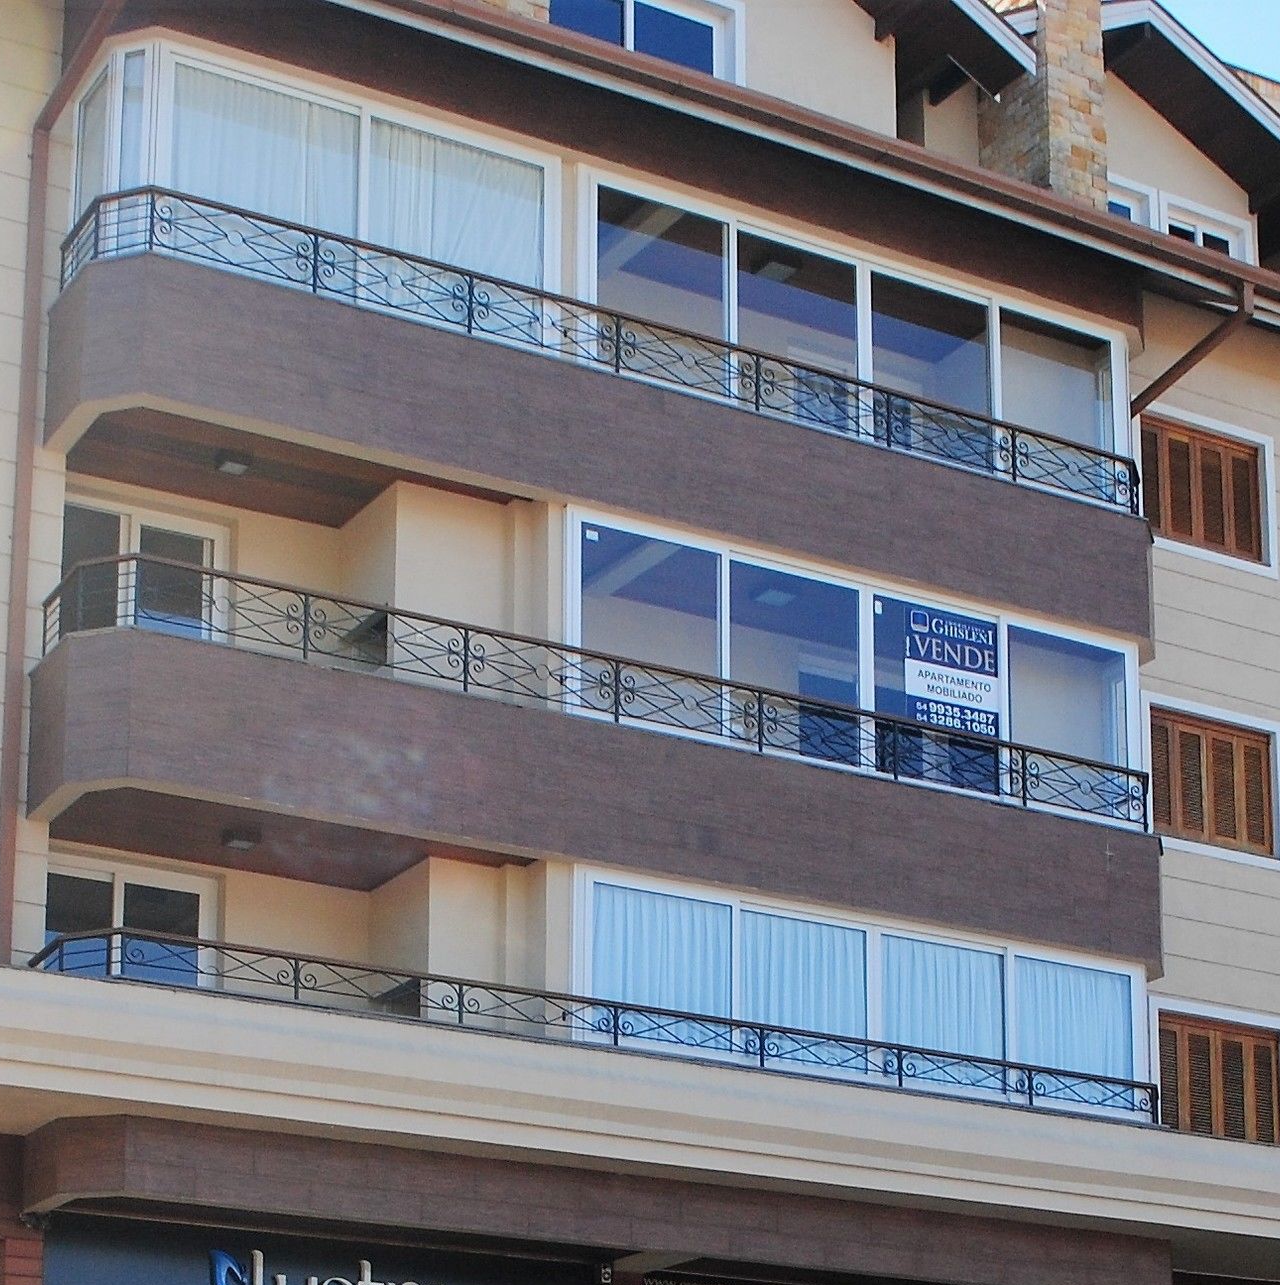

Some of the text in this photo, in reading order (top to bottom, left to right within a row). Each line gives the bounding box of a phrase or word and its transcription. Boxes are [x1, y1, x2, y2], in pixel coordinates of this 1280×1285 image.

[913, 633, 996, 673] VENDE
[917, 668, 992, 693] APARTAMENTO
[927, 684, 983, 704] MOBILIADO
